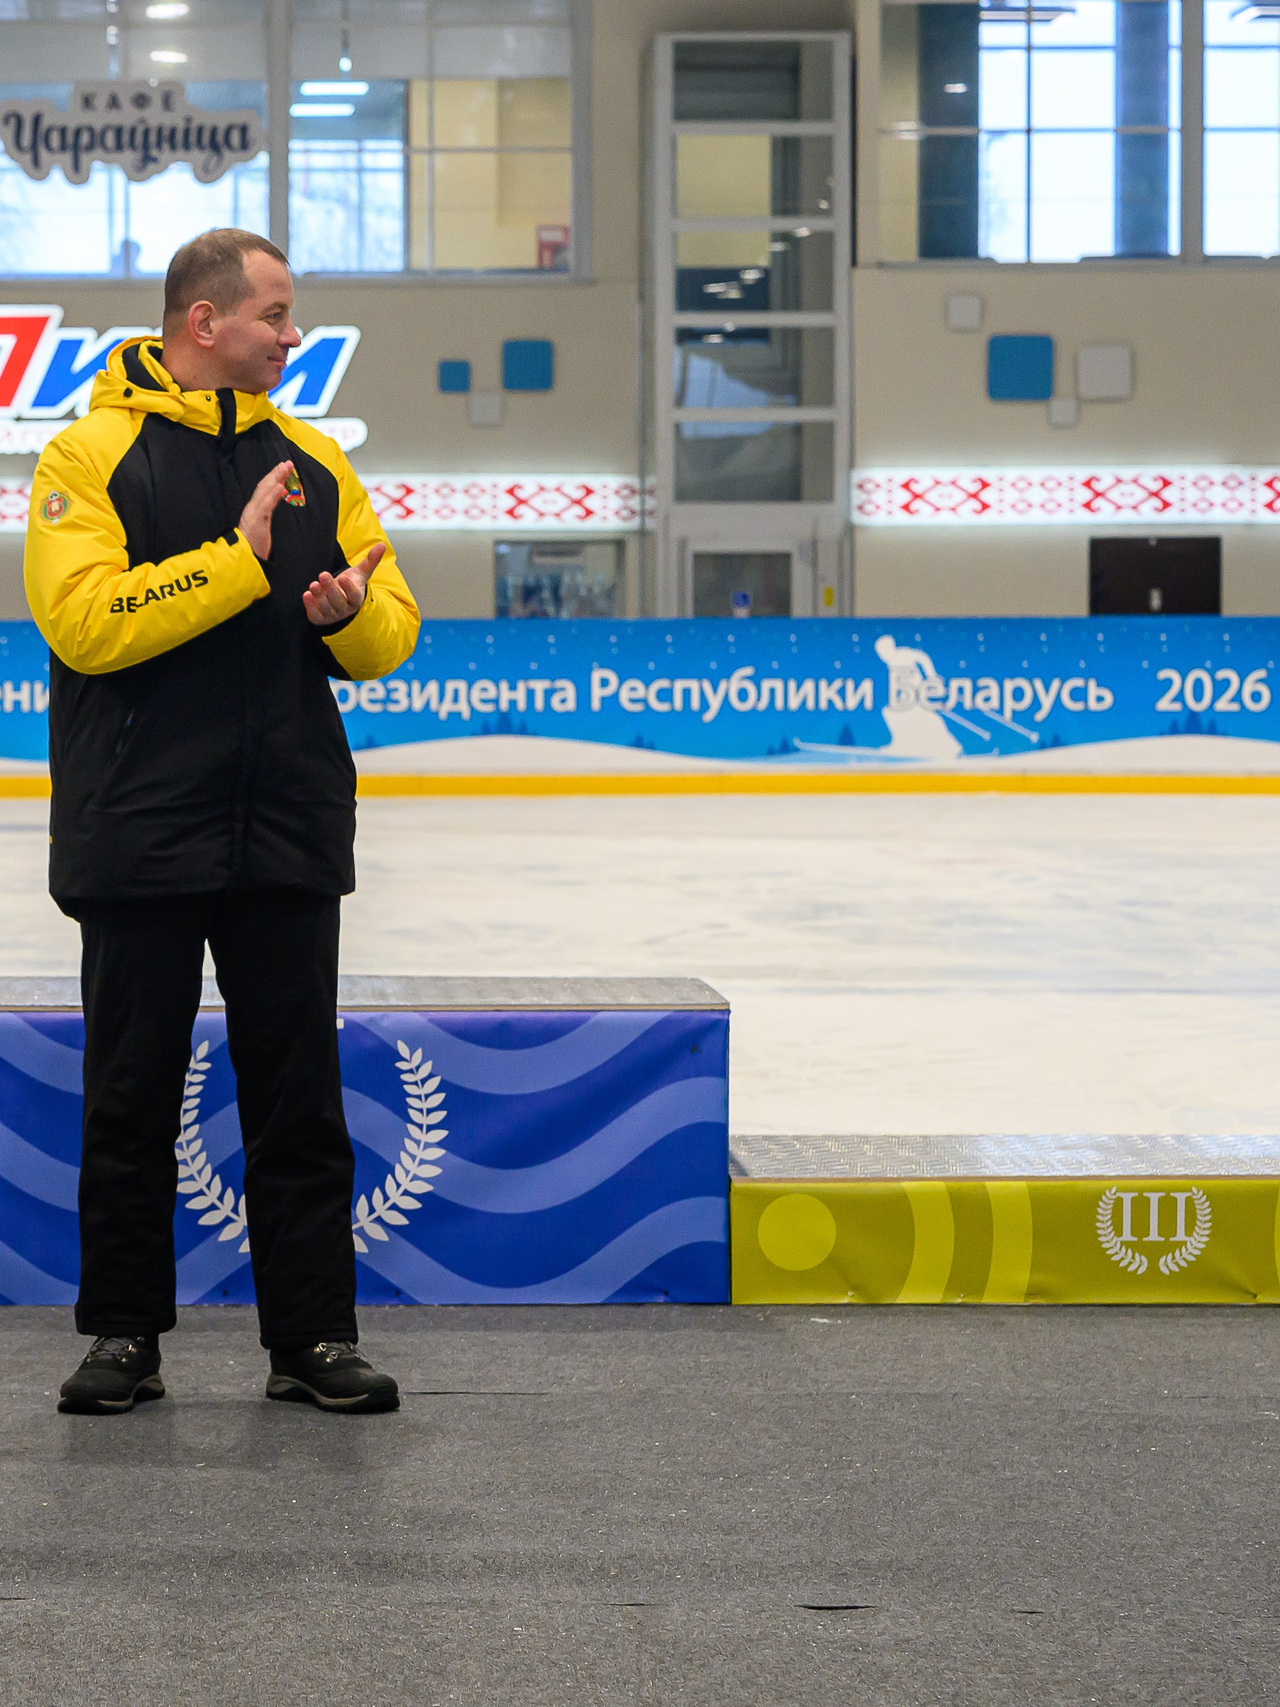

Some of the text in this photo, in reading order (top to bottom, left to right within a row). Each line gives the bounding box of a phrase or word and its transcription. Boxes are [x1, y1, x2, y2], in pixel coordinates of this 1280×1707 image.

[81, 91, 176, 111] КАФЕ
[329, 679, 577, 721] резидента
[590, 666, 874, 723] Республики
[888, 664, 1115, 723] Беларусь
[1155, 667, 1272, 713] 2026
[1116, 1192, 1192, 1242] III
